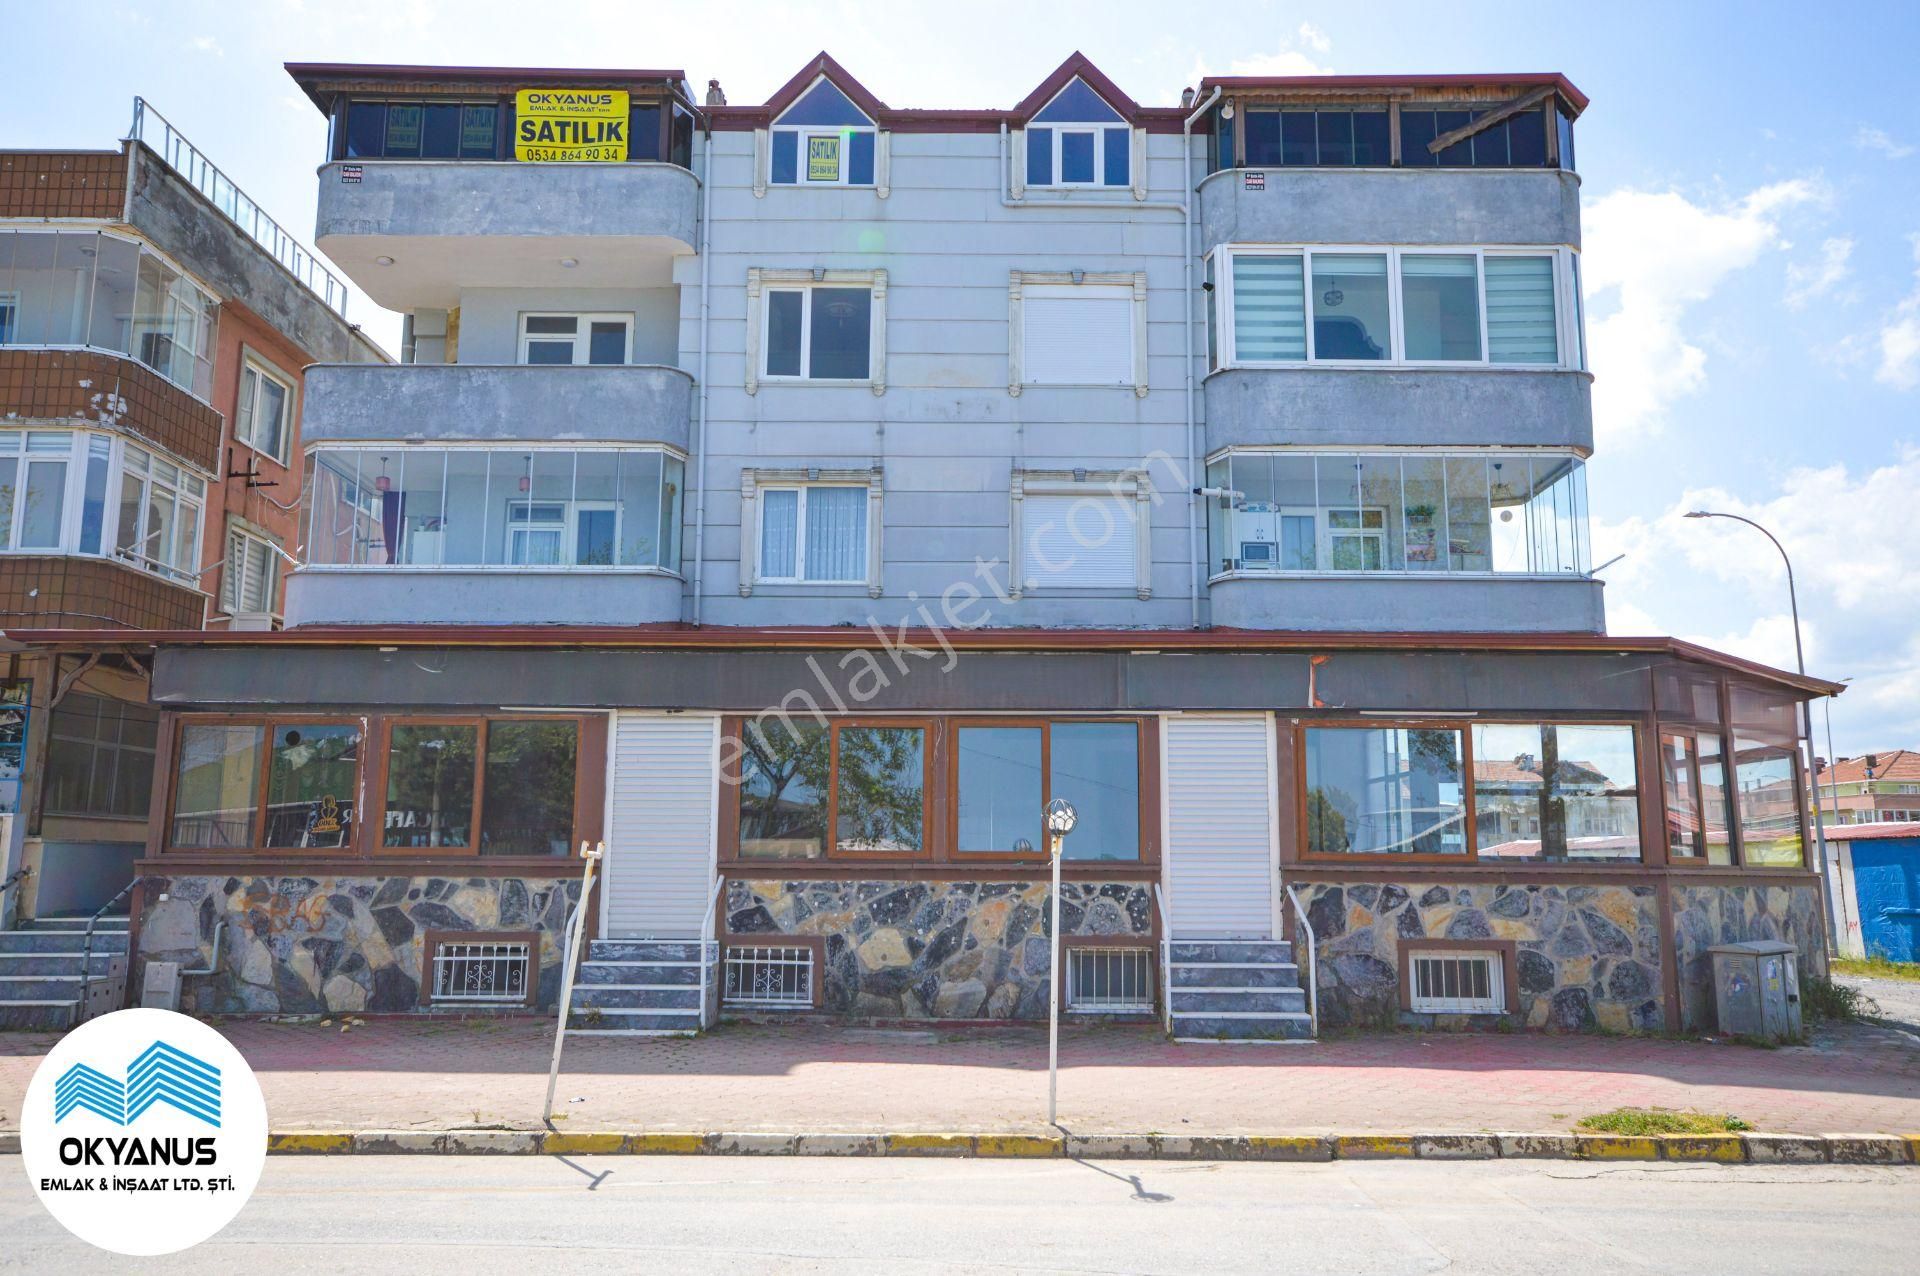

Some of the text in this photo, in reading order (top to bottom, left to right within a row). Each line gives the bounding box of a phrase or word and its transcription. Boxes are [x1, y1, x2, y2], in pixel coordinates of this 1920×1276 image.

[528, 94, 612, 104] OKYANUS
[520, 120, 623, 144] SATILIK
[527, 149, 618, 160] 0534 864 90 34
[812, 141, 837, 159] SATILIK
